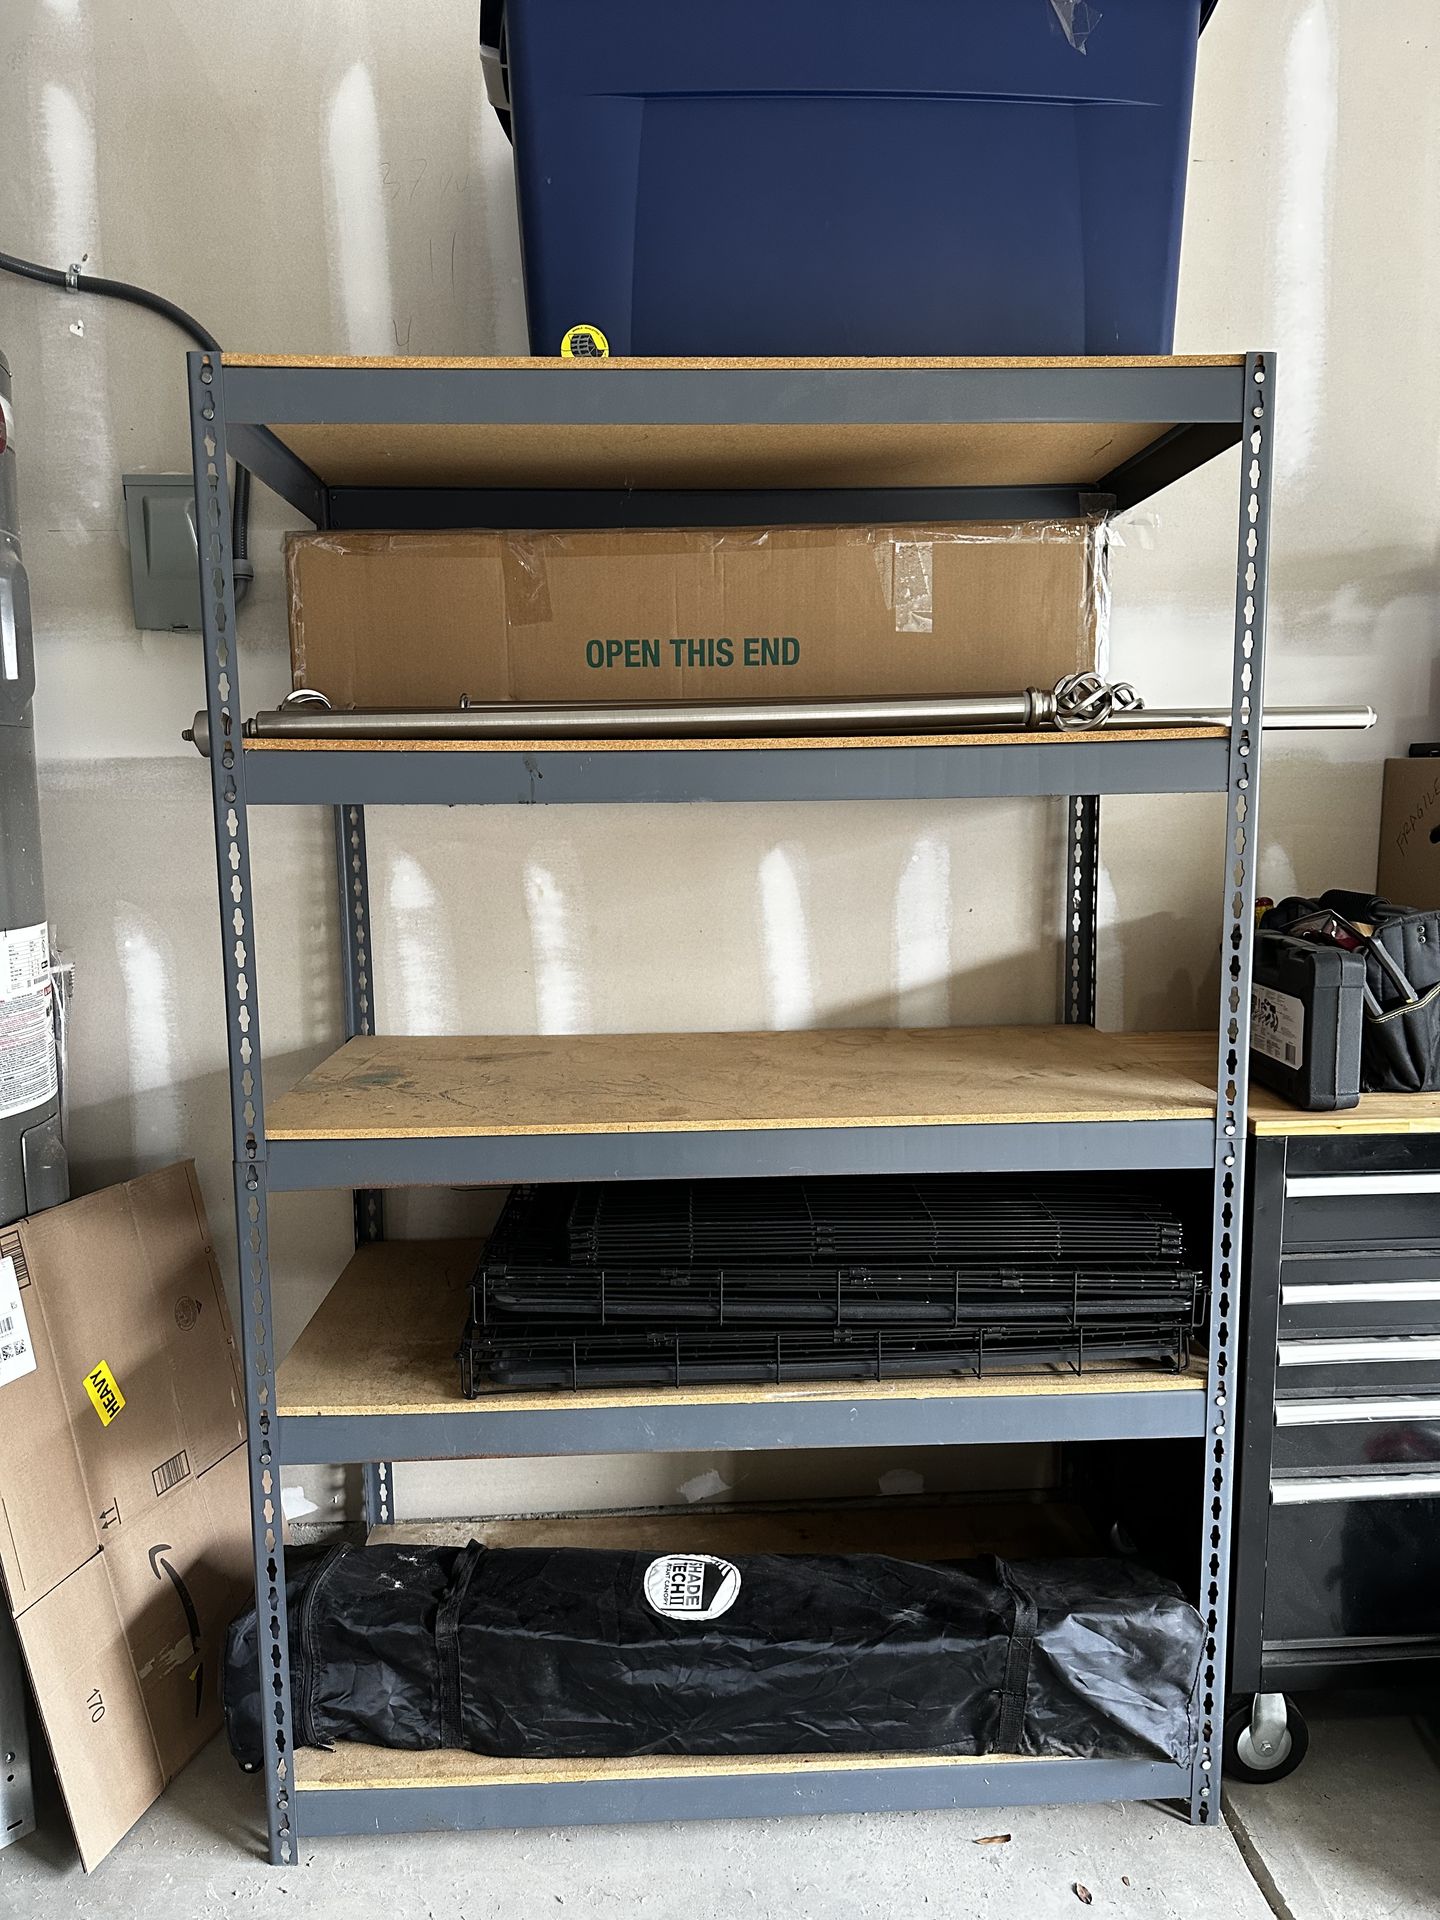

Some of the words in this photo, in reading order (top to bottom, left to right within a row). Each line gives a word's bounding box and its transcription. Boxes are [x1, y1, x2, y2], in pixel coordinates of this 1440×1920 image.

[586, 639, 660, 668] OPEN
[670, 638, 734, 667] THIS
[744, 637, 800, 666] END
[1395, 776, 1440, 857] FRAGILE
[89, 1369, 121, 1418] HEAVY
[686, 1562, 703, 1606] SHADE
[86, 1688, 106, 1723] 170
